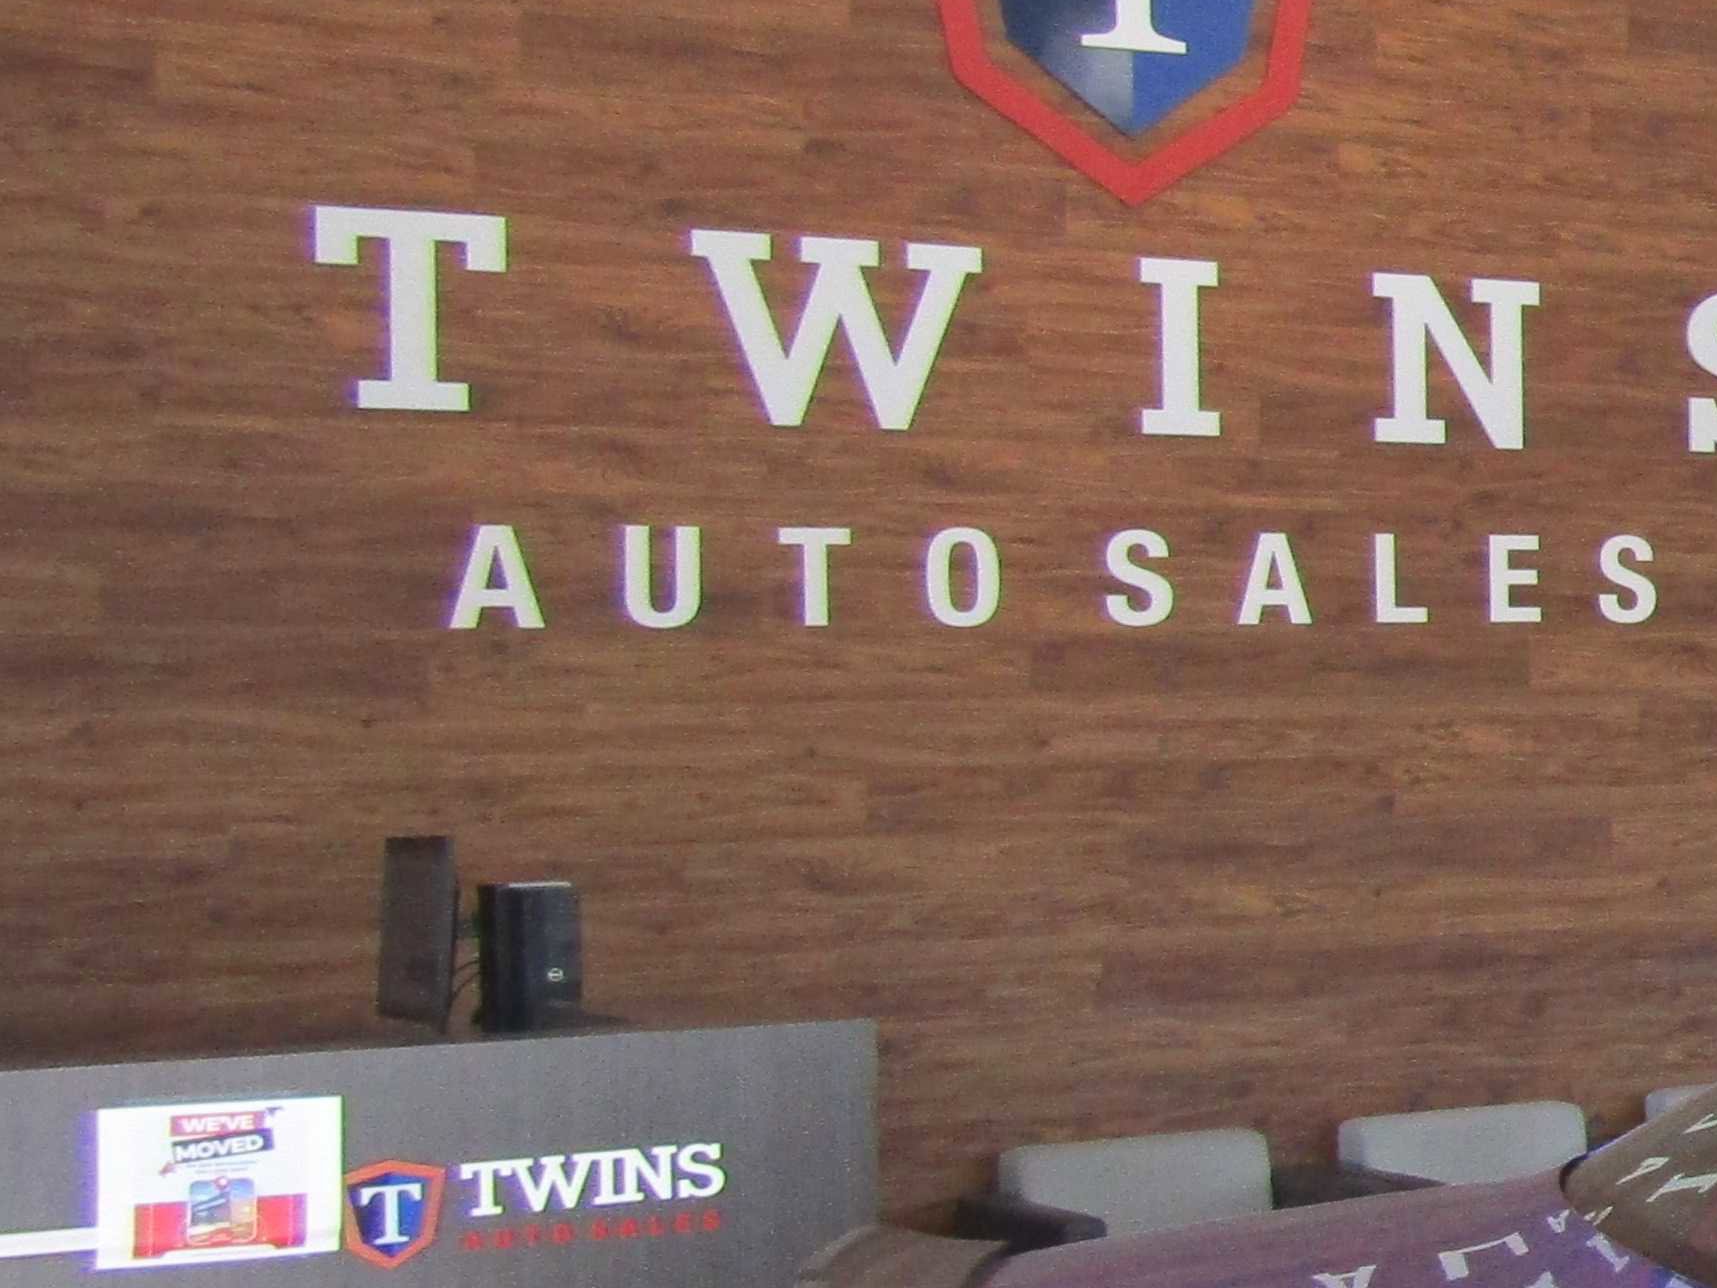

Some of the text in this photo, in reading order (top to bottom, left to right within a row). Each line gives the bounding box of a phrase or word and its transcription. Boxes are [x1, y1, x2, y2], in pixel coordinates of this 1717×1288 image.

[450, 523, 1658, 629] AUTO SALES
[175, 1134, 264, 1162] MOVED
[181, 1114, 255, 1134] WE'VE
[460, 1142, 726, 1217] TWINS
[360, 1183, 422, 1246] T
